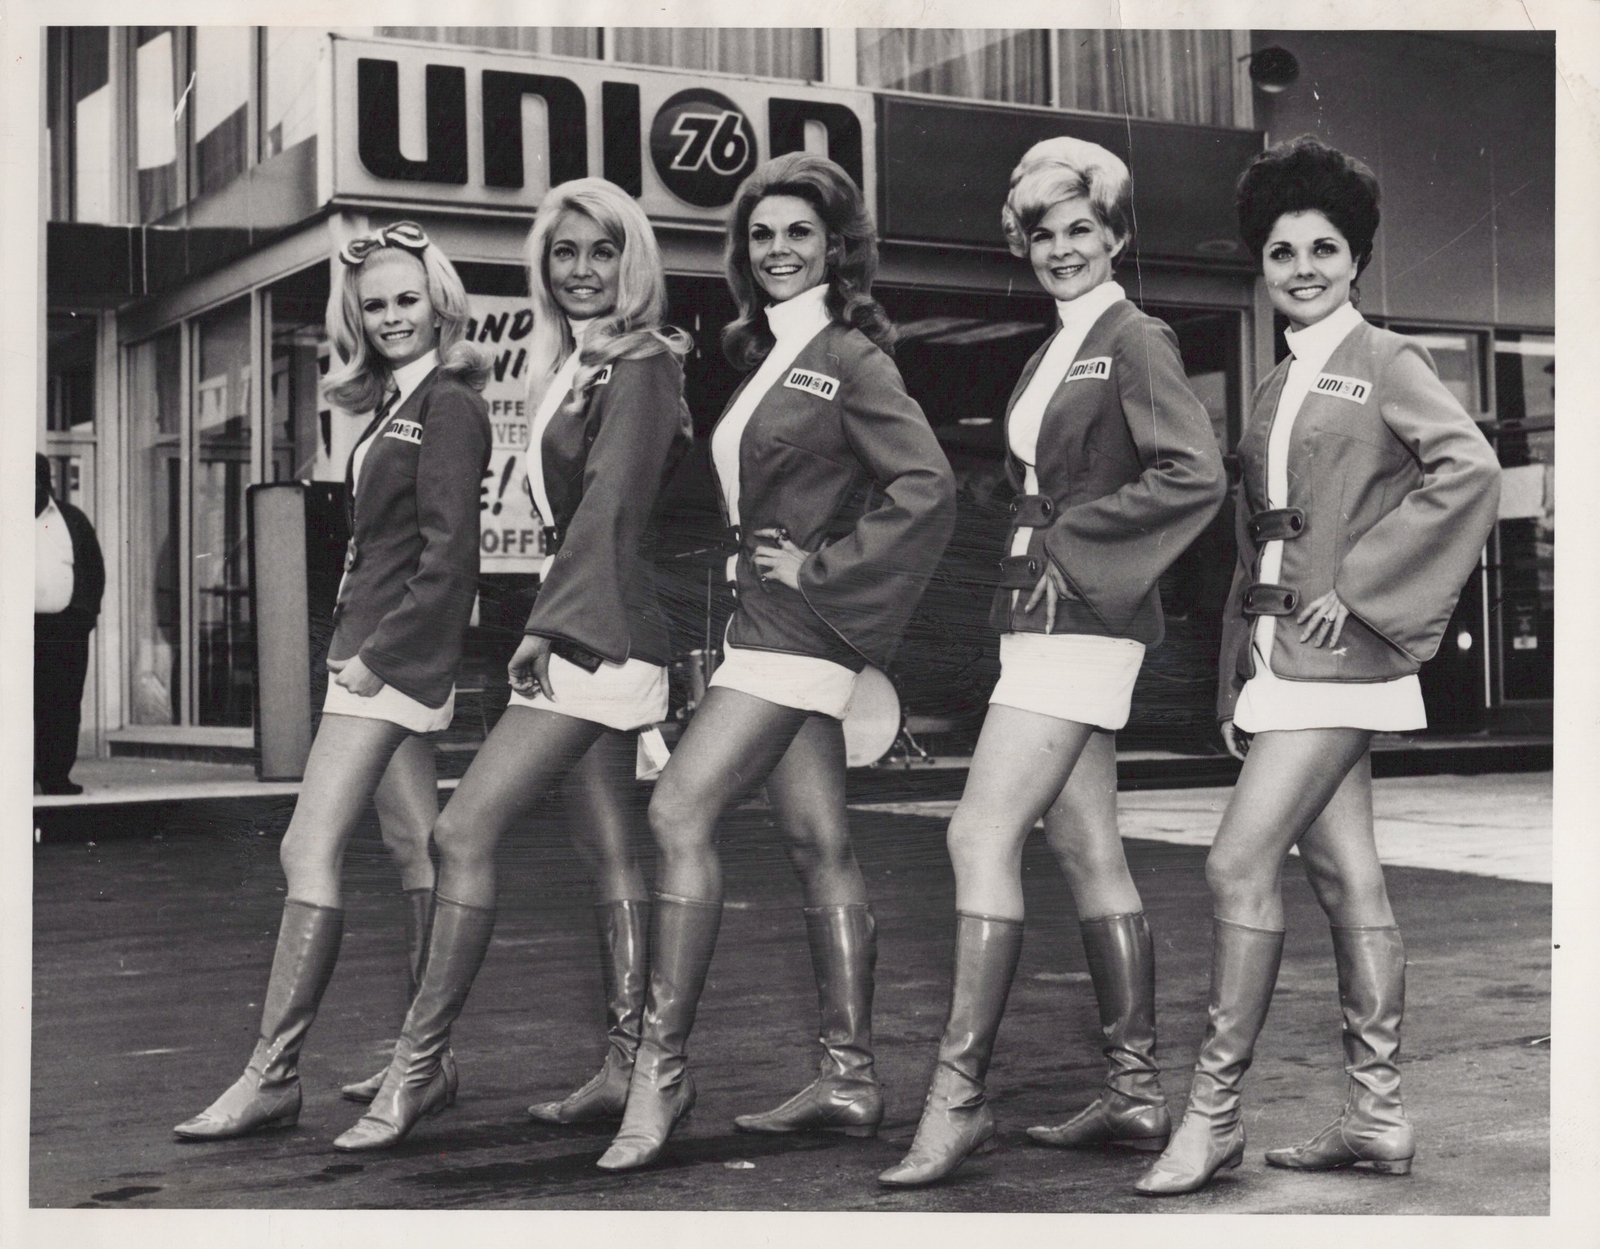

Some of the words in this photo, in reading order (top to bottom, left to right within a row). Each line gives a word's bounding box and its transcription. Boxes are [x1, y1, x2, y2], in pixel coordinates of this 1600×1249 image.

[357, 57, 863, 207] UNION
[670, 110, 749, 175] 76
[790, 372, 834, 395] UNION
[1317, 378, 1366, 398] UNION
[490, 400, 525, 416] FFE
[390, 422, 423, 440] NION
